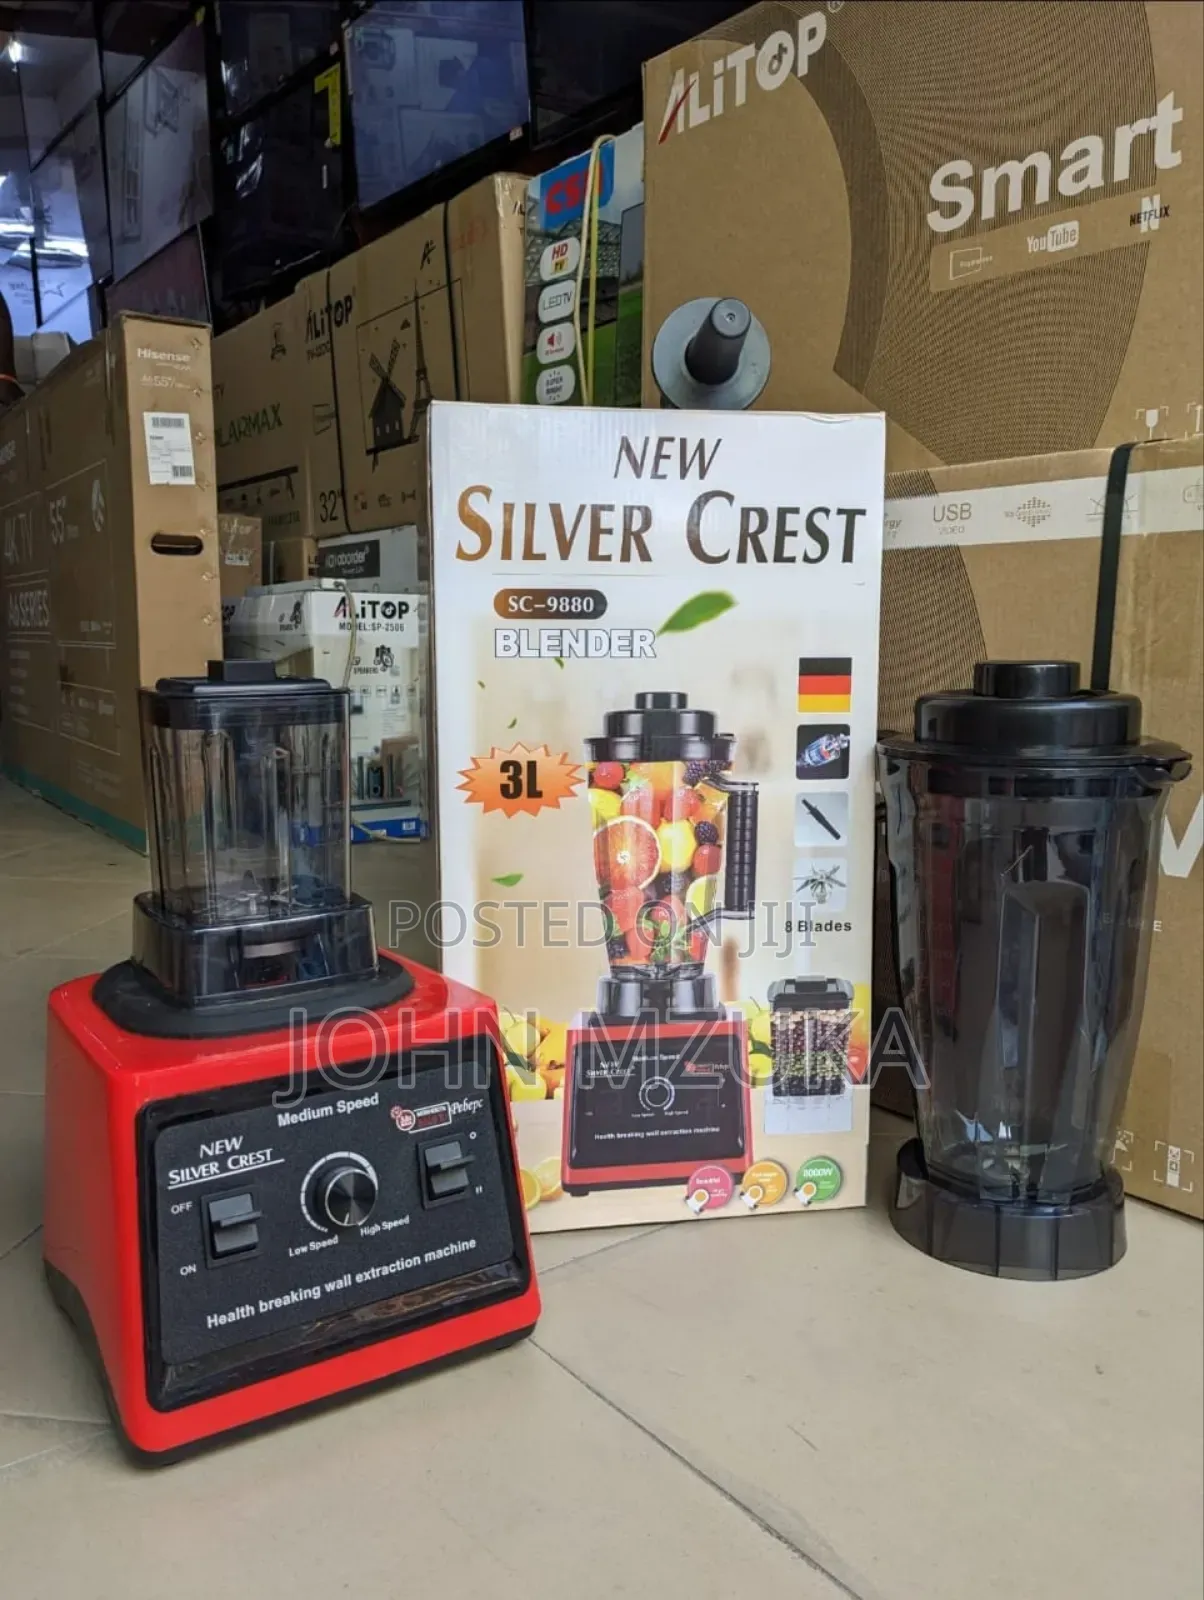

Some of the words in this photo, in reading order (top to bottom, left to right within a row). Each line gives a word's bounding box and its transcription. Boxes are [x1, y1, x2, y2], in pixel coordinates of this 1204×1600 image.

[926, 91, 1184, 233] Smart
[1129, 205, 1170, 227] NETFLIX
[1026, 219, 1080, 256] YouTube
[137, 347, 192, 362] Hisense
[613, 436, 722, 480] NEW
[455, 484, 653, 563] SILVER
[686, 490, 867, 565] CREST
[933, 502, 972, 523] USB
[507, 595, 595, 614] SC-9880
[494, 628, 657, 659] BLENDER
[499, 759, 544, 800] 3L
[784, 920, 793, 933] 8
[797, 919, 852, 932] Blades
[277, 1104, 333, 1128] Medium
[337, 1092, 380, 1115] Speed
[199, 1135, 244, 1159] NEW
[168, 1160, 219, 1185] SILVER
[227, 1148, 273, 1170] CREST
[171, 1201, 193, 1215] OFF
[360, 1224, 380, 1238] High
[381, 1215, 410, 1232] Speed
[288, 1241, 307, 1257] Low
[309, 1235, 339, 1252] Speed
[180, 1263, 197, 1276] ON
[206, 1303, 255, 1329] Health
[259, 1284, 321, 1314] breaking
[324, 1273, 352, 1293] wall
[355, 1254, 421, 1284] extraction
[424, 1238, 477, 1262] machine
